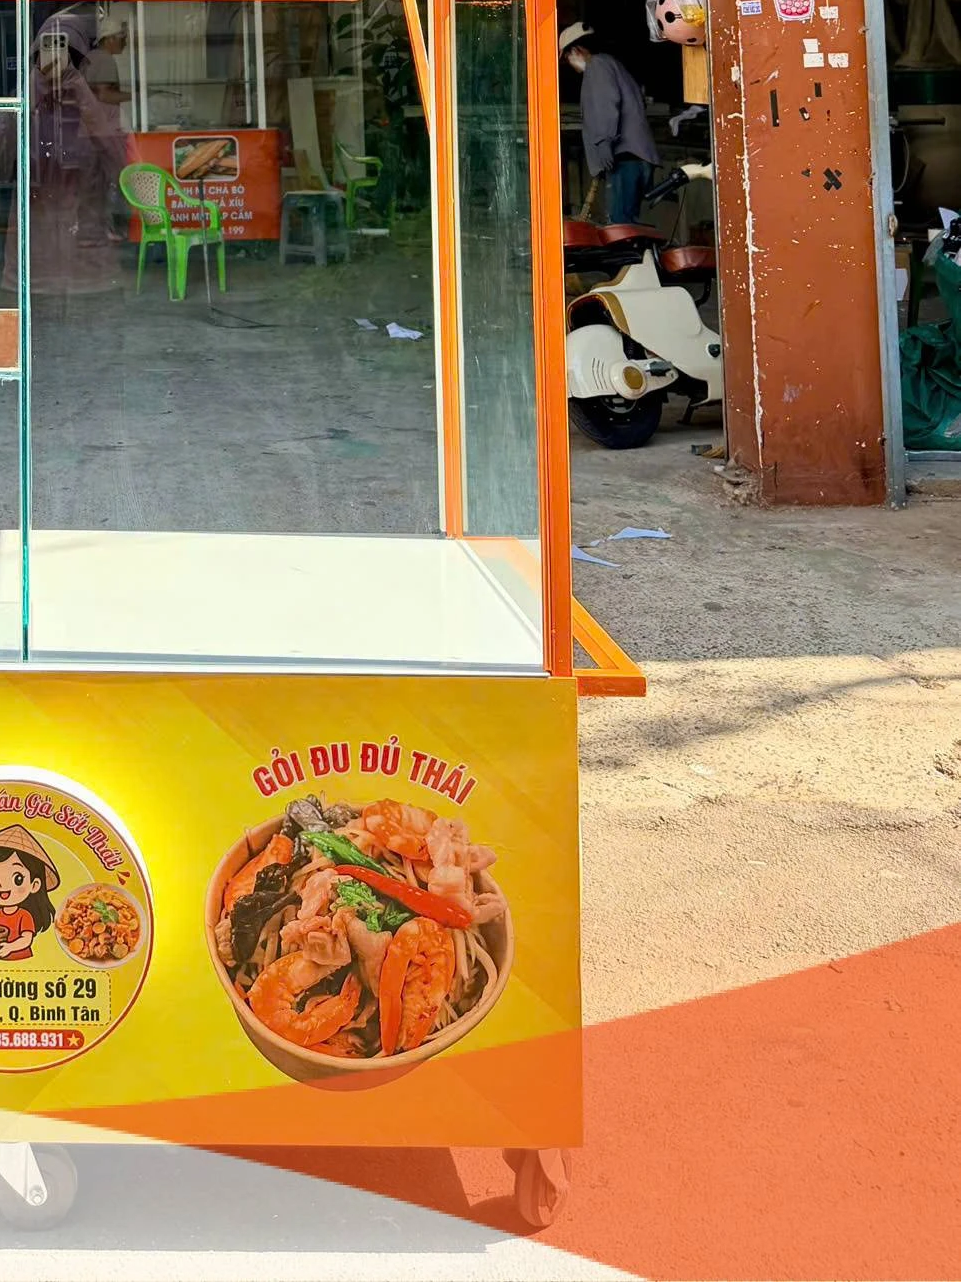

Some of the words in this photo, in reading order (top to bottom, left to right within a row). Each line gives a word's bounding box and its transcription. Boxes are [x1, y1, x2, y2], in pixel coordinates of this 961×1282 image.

[253, 748, 304, 796] GỎI
[310, 743, 350, 776] ĐU
[360, 736, 401, 775] ĐỦ
[409, 751, 476, 805] THÁI
[25, 793, 54, 819] Gà
[83, 824, 125, 870] Thái
[44, 974, 68, 999] số
[73, 977, 97, 999] 29
[8, 1005, 24, 1022] Q.
[29, 1005, 66, 1022] Bình
[70, 1005, 100, 1022] Tân
